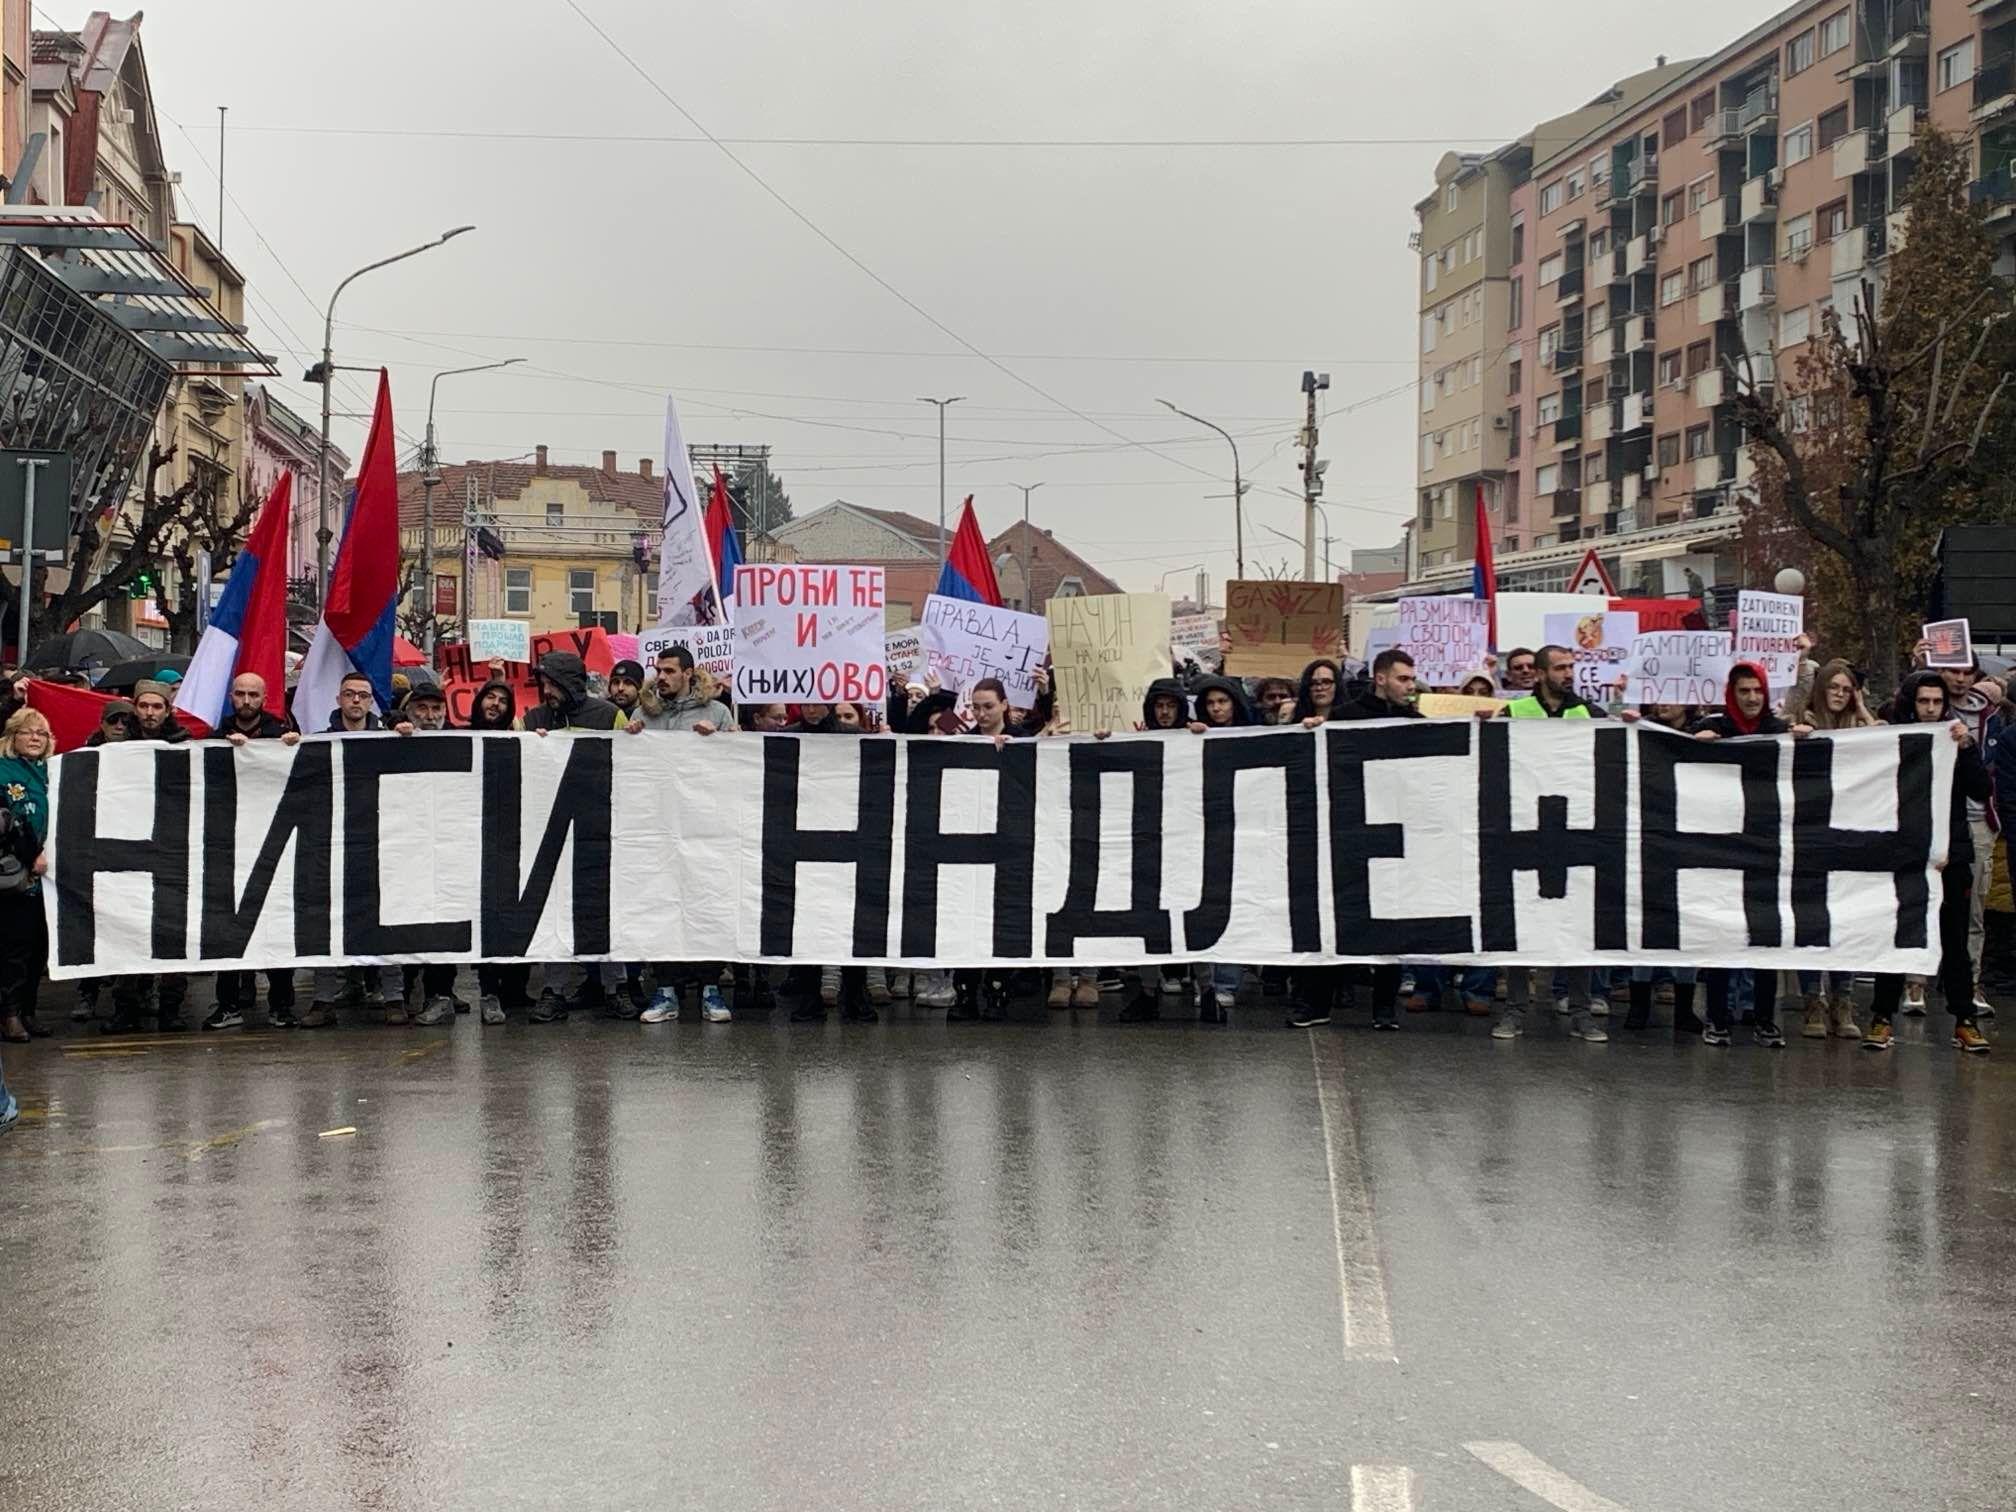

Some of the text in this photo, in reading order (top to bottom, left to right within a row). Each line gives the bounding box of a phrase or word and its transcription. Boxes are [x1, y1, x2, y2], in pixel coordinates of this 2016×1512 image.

[849, 570, 883, 608] ЋЕ
[1742, 598, 1800, 617] ZATVORENI
[797, 613, 817, 648] И
[925, 599, 1020, 645] ПРАВДА
[1050, 594, 1134, 648] НАЧИН
[1742, 616, 1798, 634] FAKULTETI
[706, 629, 720, 643] DA
[892, 637, 920, 650] МОРА
[971, 644, 993, 663] ЈЕ
[1579, 666, 1600, 684] СЕ
[56, 721, 1934, 967] НИСИ НАДЛЕЖАН
